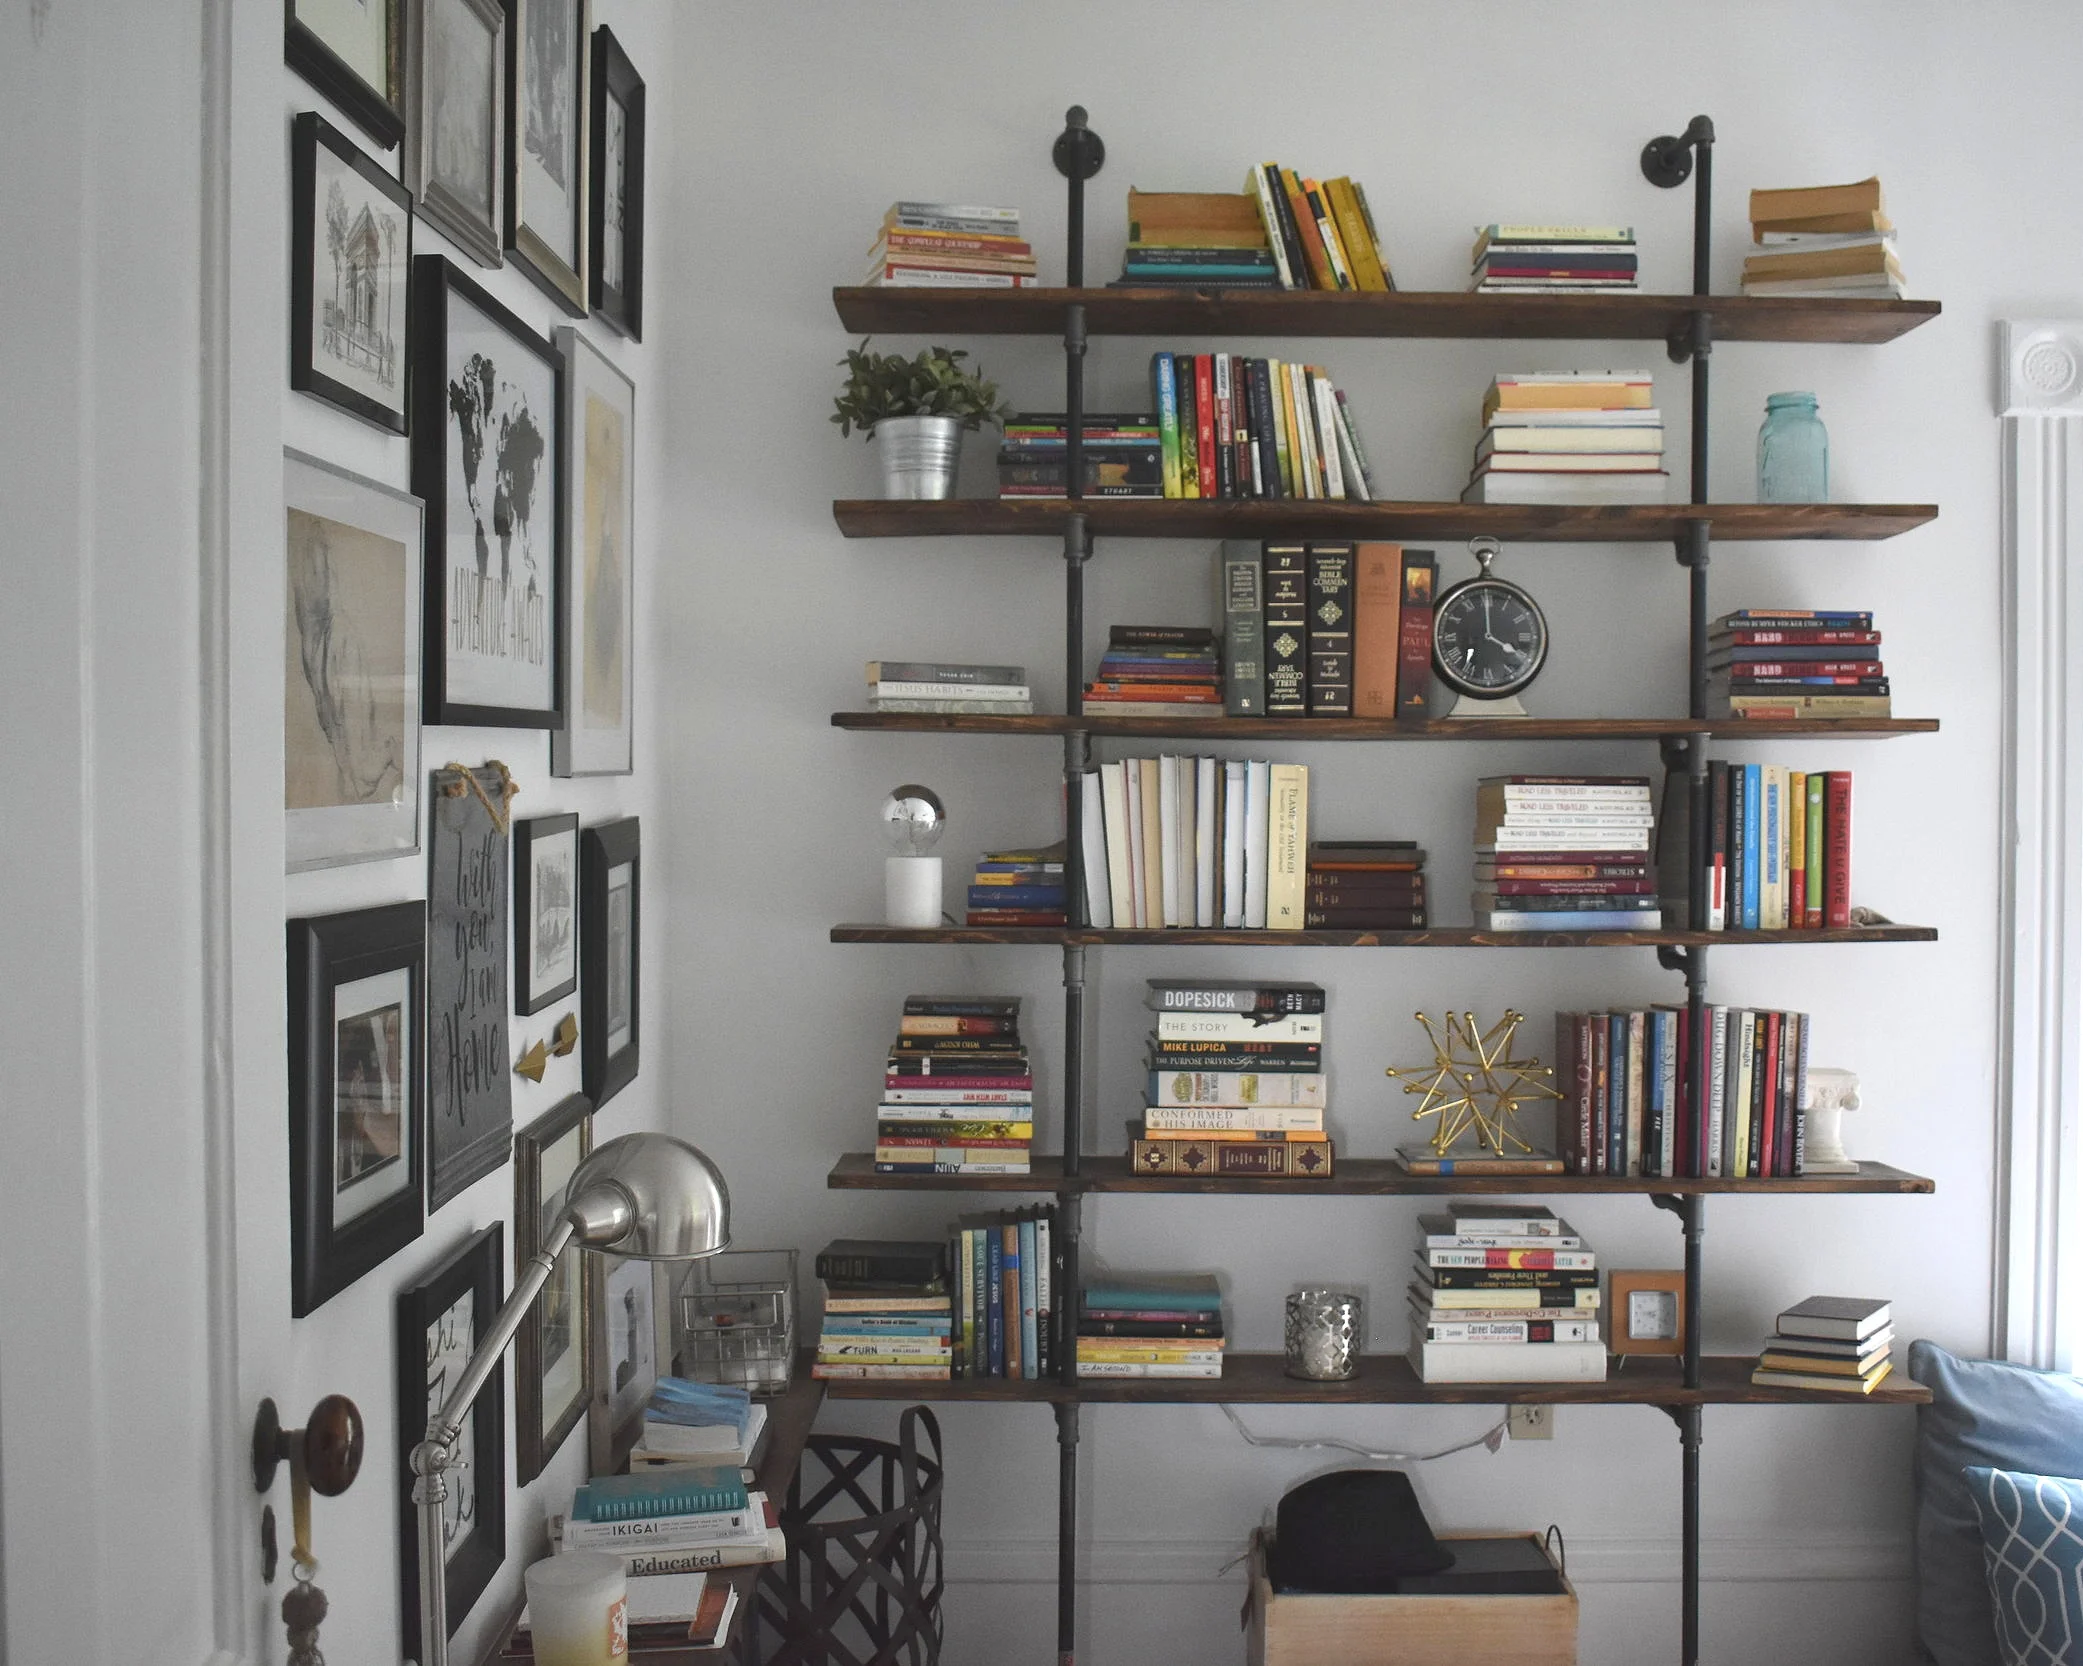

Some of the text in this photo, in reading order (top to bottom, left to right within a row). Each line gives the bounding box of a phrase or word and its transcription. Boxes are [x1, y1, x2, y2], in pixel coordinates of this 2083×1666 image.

[1159, 357, 1173, 432] DARING GREATLY
[1288, 787, 1299, 820] FLAME
[1835, 788, 1848, 815] THE
[1835, 817, 1847, 853] HATE
[1287, 833, 1298, 873] YAHWEH
[1834, 871, 1846, 905] GIVE
[1164, 990, 1236, 1009] DOPESICK
[1286, 993, 1294, 1011] BETH
[1166, 1022, 1229, 1032] THE STORY
[962, 1041, 980, 1049] WHO
[1163, 1042, 1227, 1052] MIKE LUPICA
[1243, 1043, 1273, 1052] HEAT
[1743, 1023, 1753, 1068] Hindsight
[441, 1001, 501, 1127] Home
[1170, 1057, 1202, 1065] PURPOSE
[1204, 1057, 1233, 1065] DRIVEN
[1713, 1042, 1724, 1080] DOWN
[1580, 1096, 1589, 1121] Circle
[1711, 1083, 1723, 1113] DEEP
[1151, 1109, 1233, 1120] CONFORMED
[1164, 1119, 1233, 1129] HIS IMAGE
[1796, 1114, 1806, 1138] JOHN
[1580, 1122, 1589, 1148] Maker
[1437, 1255, 1449, 1264] THE
[976, 1269, 984, 1310] SURVIVOR
[1467, 1323, 1489, 1334] Career
[1490, 1323, 1524, 1336] Counseling
[853, 1346, 878, 1355] TURN
[612, 1523, 659, 1537] IKIGAI
[631, 1550, 722, 1575] Educated
